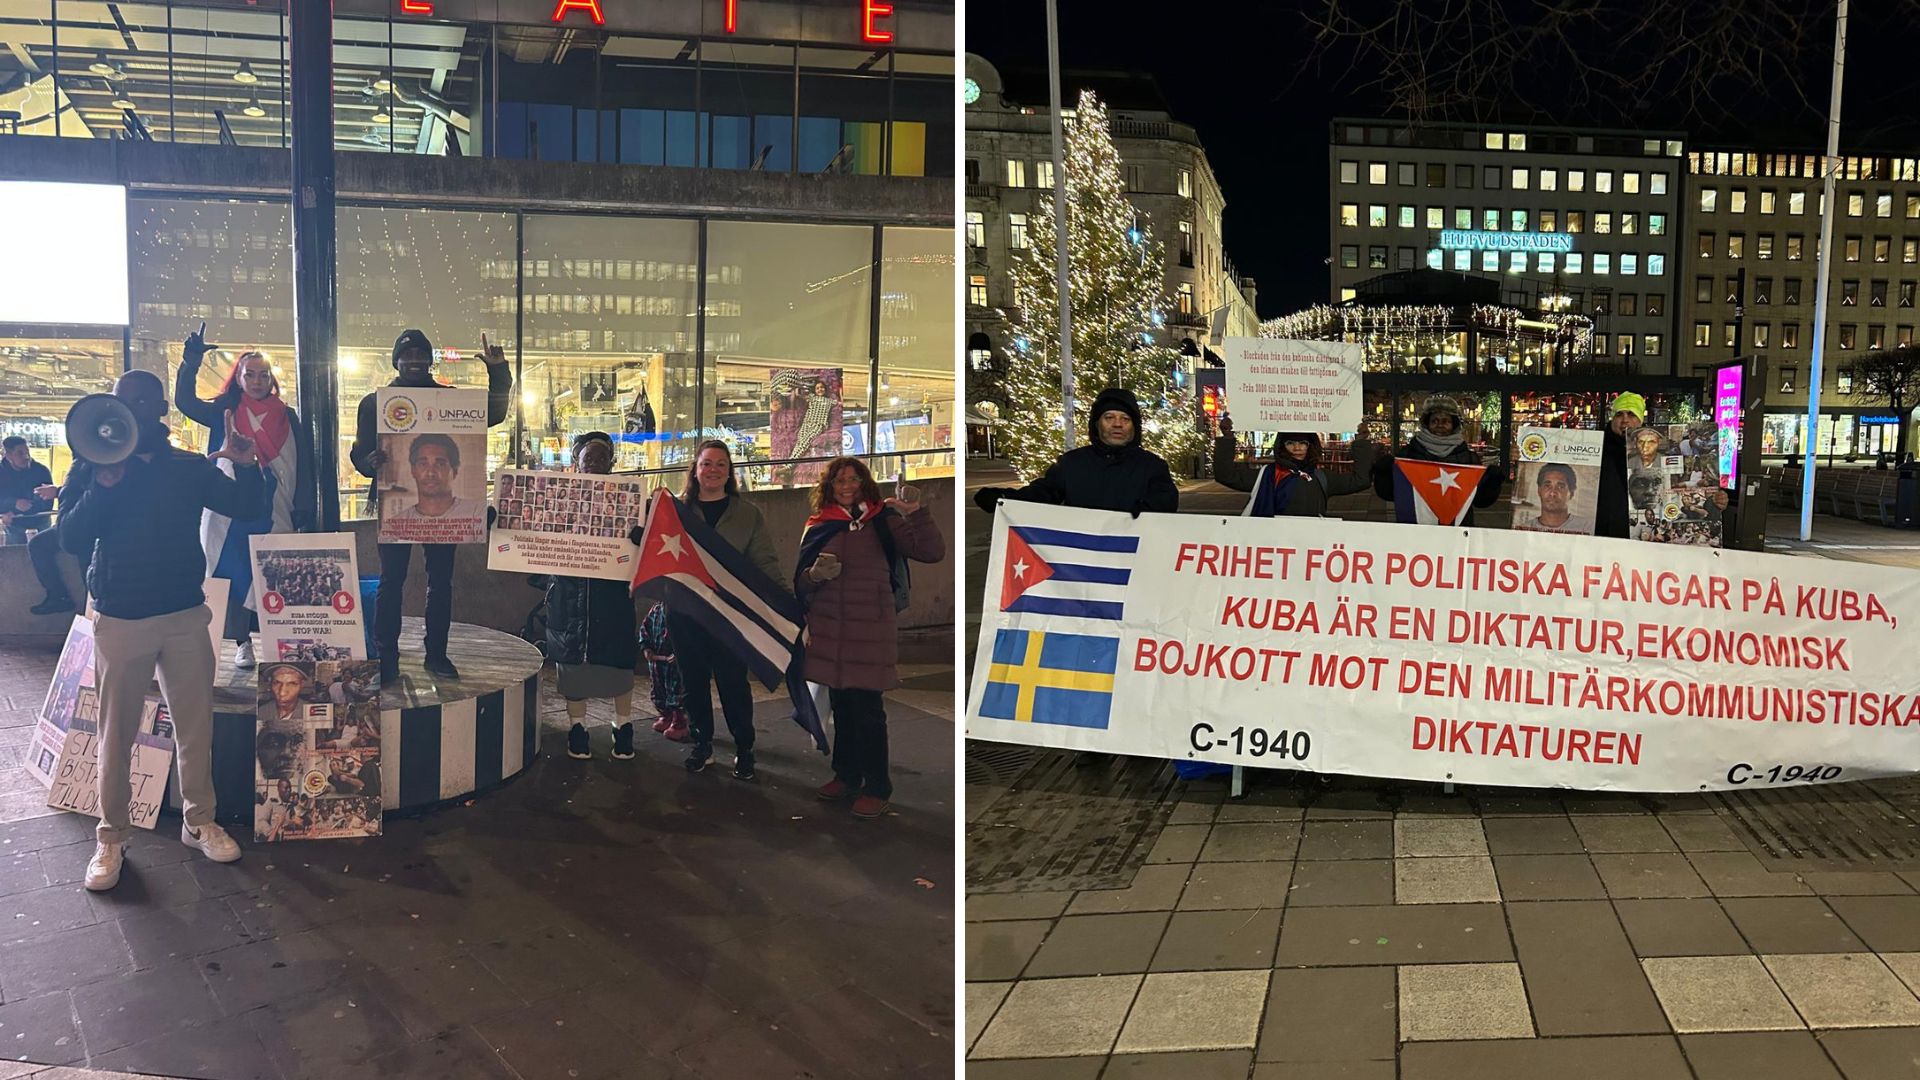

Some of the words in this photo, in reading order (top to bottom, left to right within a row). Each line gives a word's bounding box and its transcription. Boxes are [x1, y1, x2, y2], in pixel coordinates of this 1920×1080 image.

[1442, 233, 1571, 249] HUFVUDSTADEN
[439, 408, 486, 419] UNPACU
[1860, 415, 1900, 423] Handelsbank
[1563, 445, 1601, 454] UNPACU
[1175, 544, 1296, 580] FRIHET
[1304, 543, 1373, 584] FÖR
[1385, 552, 1572, 598] POLITISKA
[1583, 562, 1731, 610] FÅNGAR
[1743, 576, 1787, 617] PÅ
[1796, 584, 1897, 629] KUBA,
[1221, 595, 1320, 635] KUBA
[1328, 596, 1378, 638] ÄR
[1389, 605, 1436, 641] EN
[1134, 638, 1302, 684] BOJKOTT
[1309, 653, 1390, 692] MOT
[1397, 659, 1473, 699] DEN
[1484, 666, 1920, 728] MILITÄRKOMMUNISTISKA
[1190, 722, 1313, 761] C-1940
[1411, 715, 1642, 766] DIKTATUREN
[1726, 762, 1843, 785] C-1940
